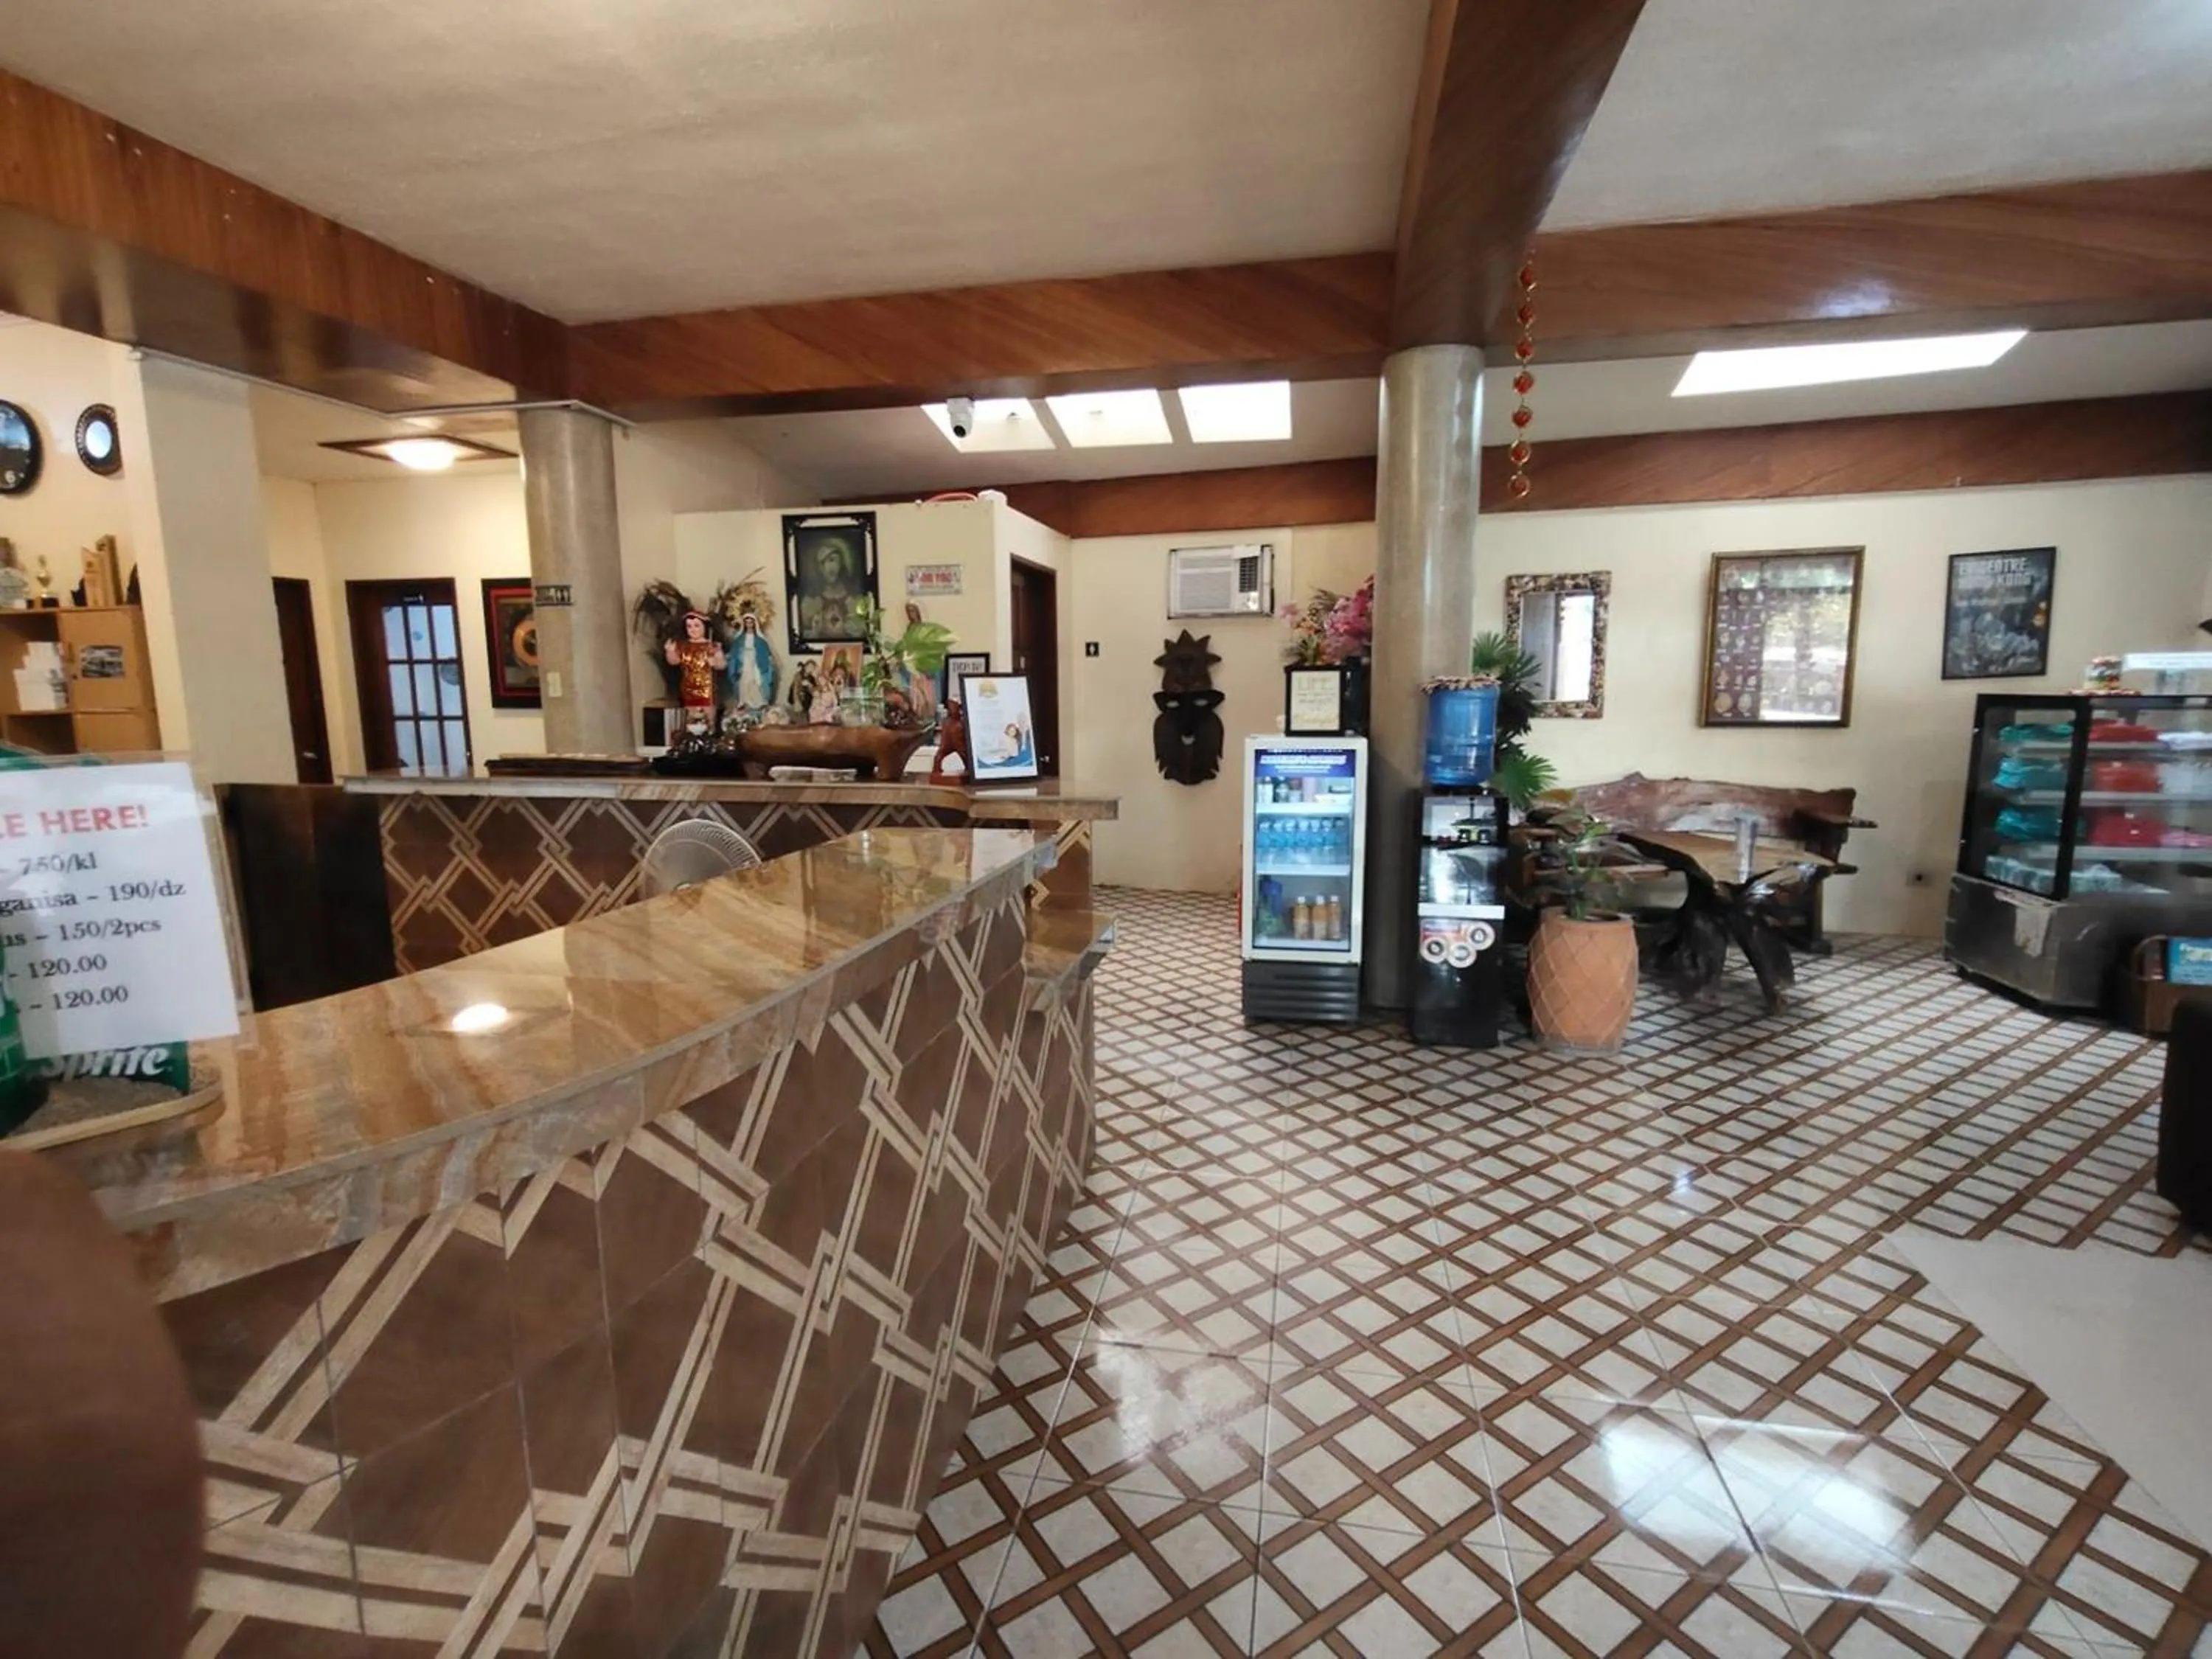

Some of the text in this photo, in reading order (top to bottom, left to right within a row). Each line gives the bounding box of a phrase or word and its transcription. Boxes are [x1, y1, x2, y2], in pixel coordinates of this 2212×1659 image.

[40, 804, 149, 835] HERE!
[108, 880, 187, 902] 190/dz
[59, 919, 161, 941] 150/2pcs
[28, 954, 108, 979] 120.00
[53, 985, 129, 1010] 120.00
